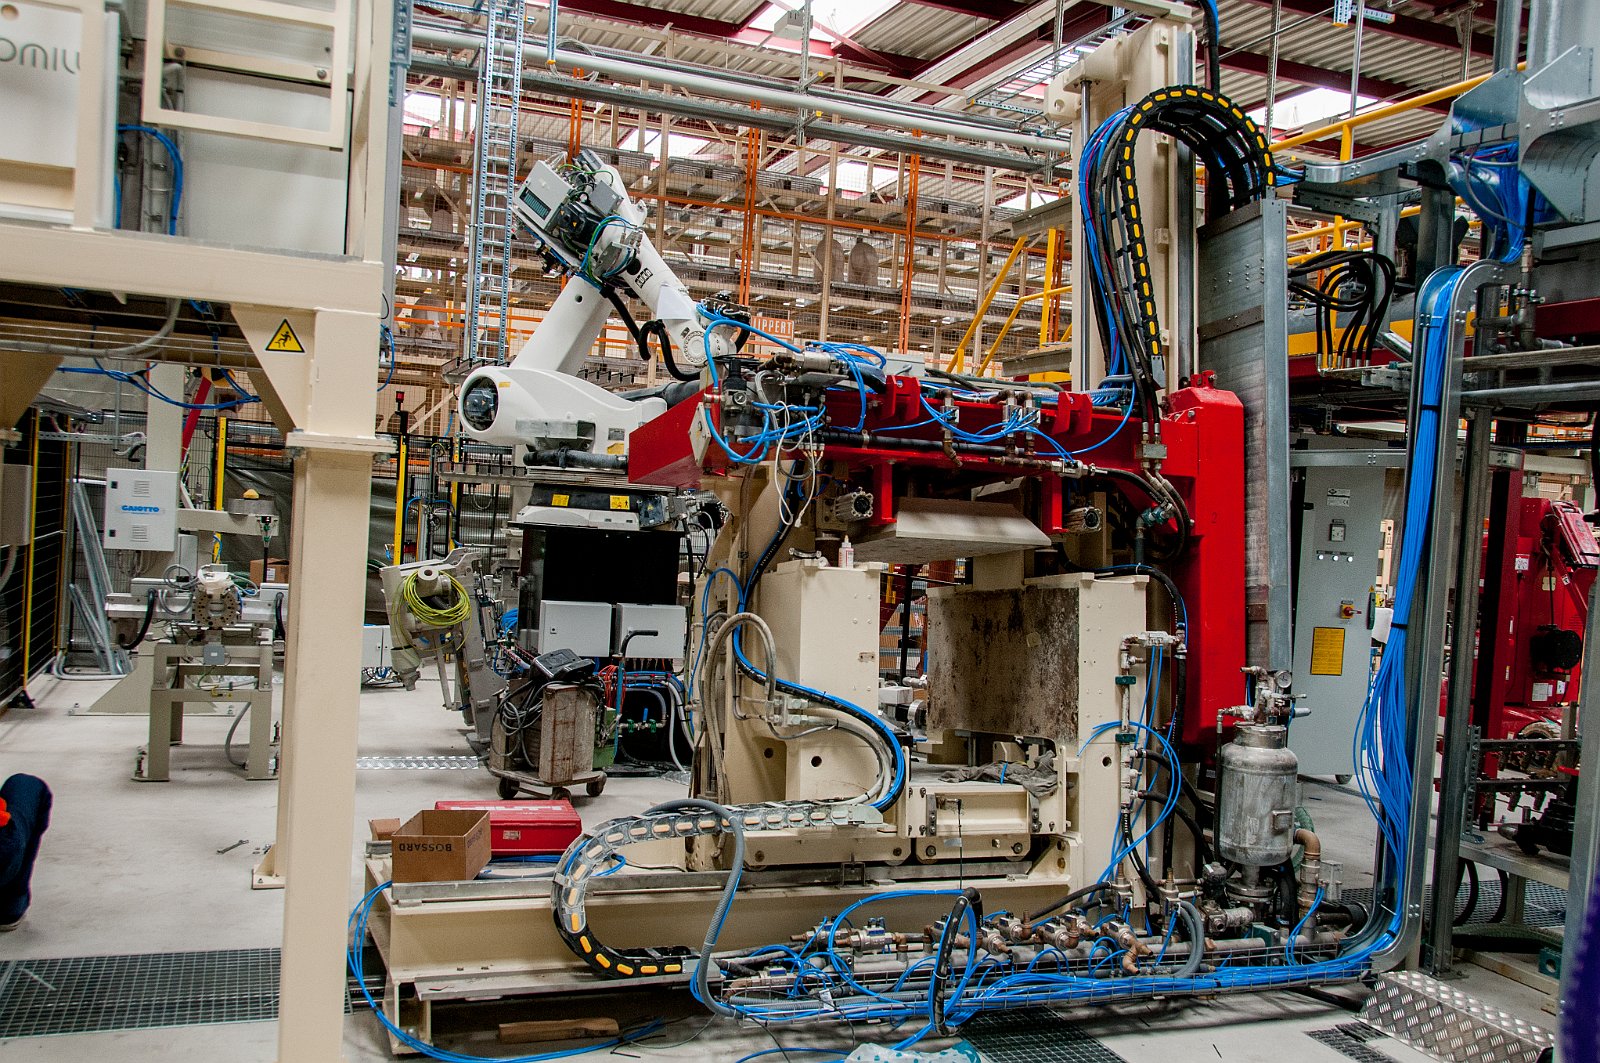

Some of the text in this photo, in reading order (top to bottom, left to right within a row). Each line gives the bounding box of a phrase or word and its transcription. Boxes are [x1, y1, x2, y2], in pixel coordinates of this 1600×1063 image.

[635, 268, 653, 288] KUKA
[121, 505, 160, 513] GAIOTTO
[399, 843, 452, 852] BOSSARD
